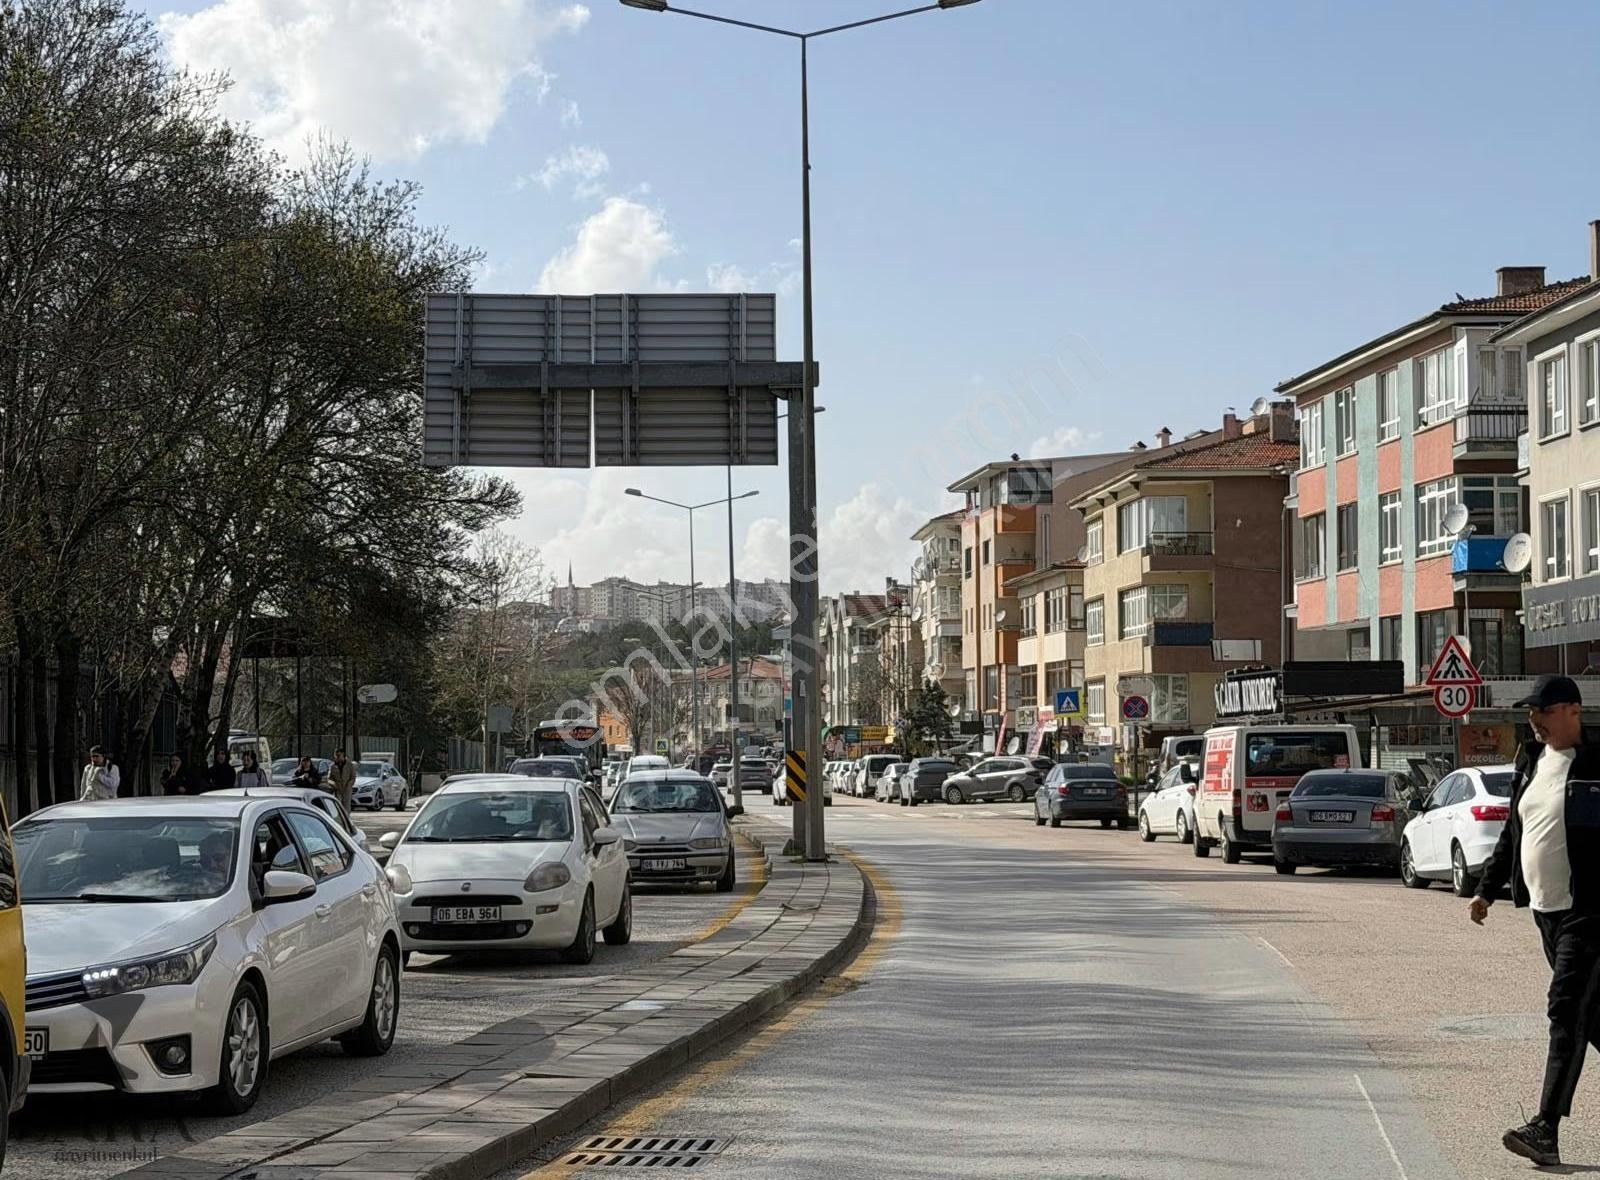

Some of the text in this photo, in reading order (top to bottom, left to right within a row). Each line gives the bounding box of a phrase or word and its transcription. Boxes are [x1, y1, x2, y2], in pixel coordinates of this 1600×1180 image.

[1443, 687, 1466, 706] 30
[438, 908, 451, 920] 06
[455, 908, 475, 920] EBA
